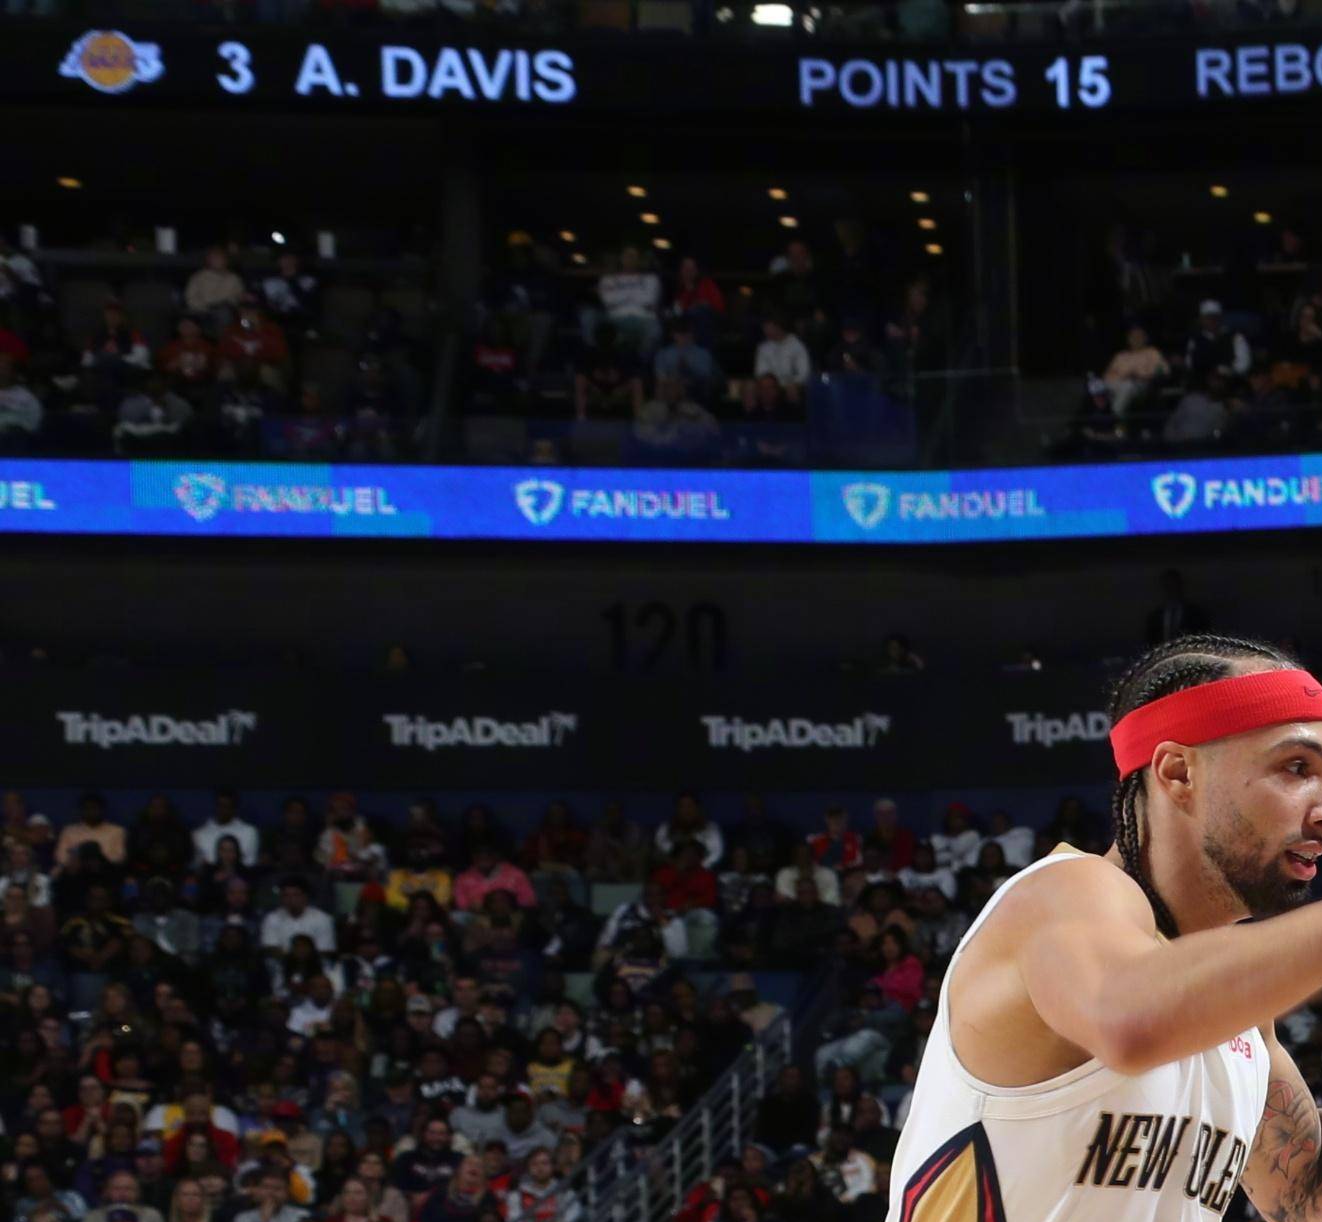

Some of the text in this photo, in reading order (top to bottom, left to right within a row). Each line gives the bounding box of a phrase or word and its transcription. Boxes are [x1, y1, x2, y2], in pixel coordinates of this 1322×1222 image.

[217, 41, 577, 103] 3 A. DAVIS
[799, 55, 1112, 108] POINTS 15
[570, 488, 729, 520] FANDUEL
[899, 488, 1045, 520] FANDUEL
[601, 600, 727, 677] 120
[57, 711, 229, 749] TripADeal
[383, 714, 550, 751] TripADeal
[701, 715, 863, 751] TripADeal
[1074, 1110, 1191, 1191] NEW
